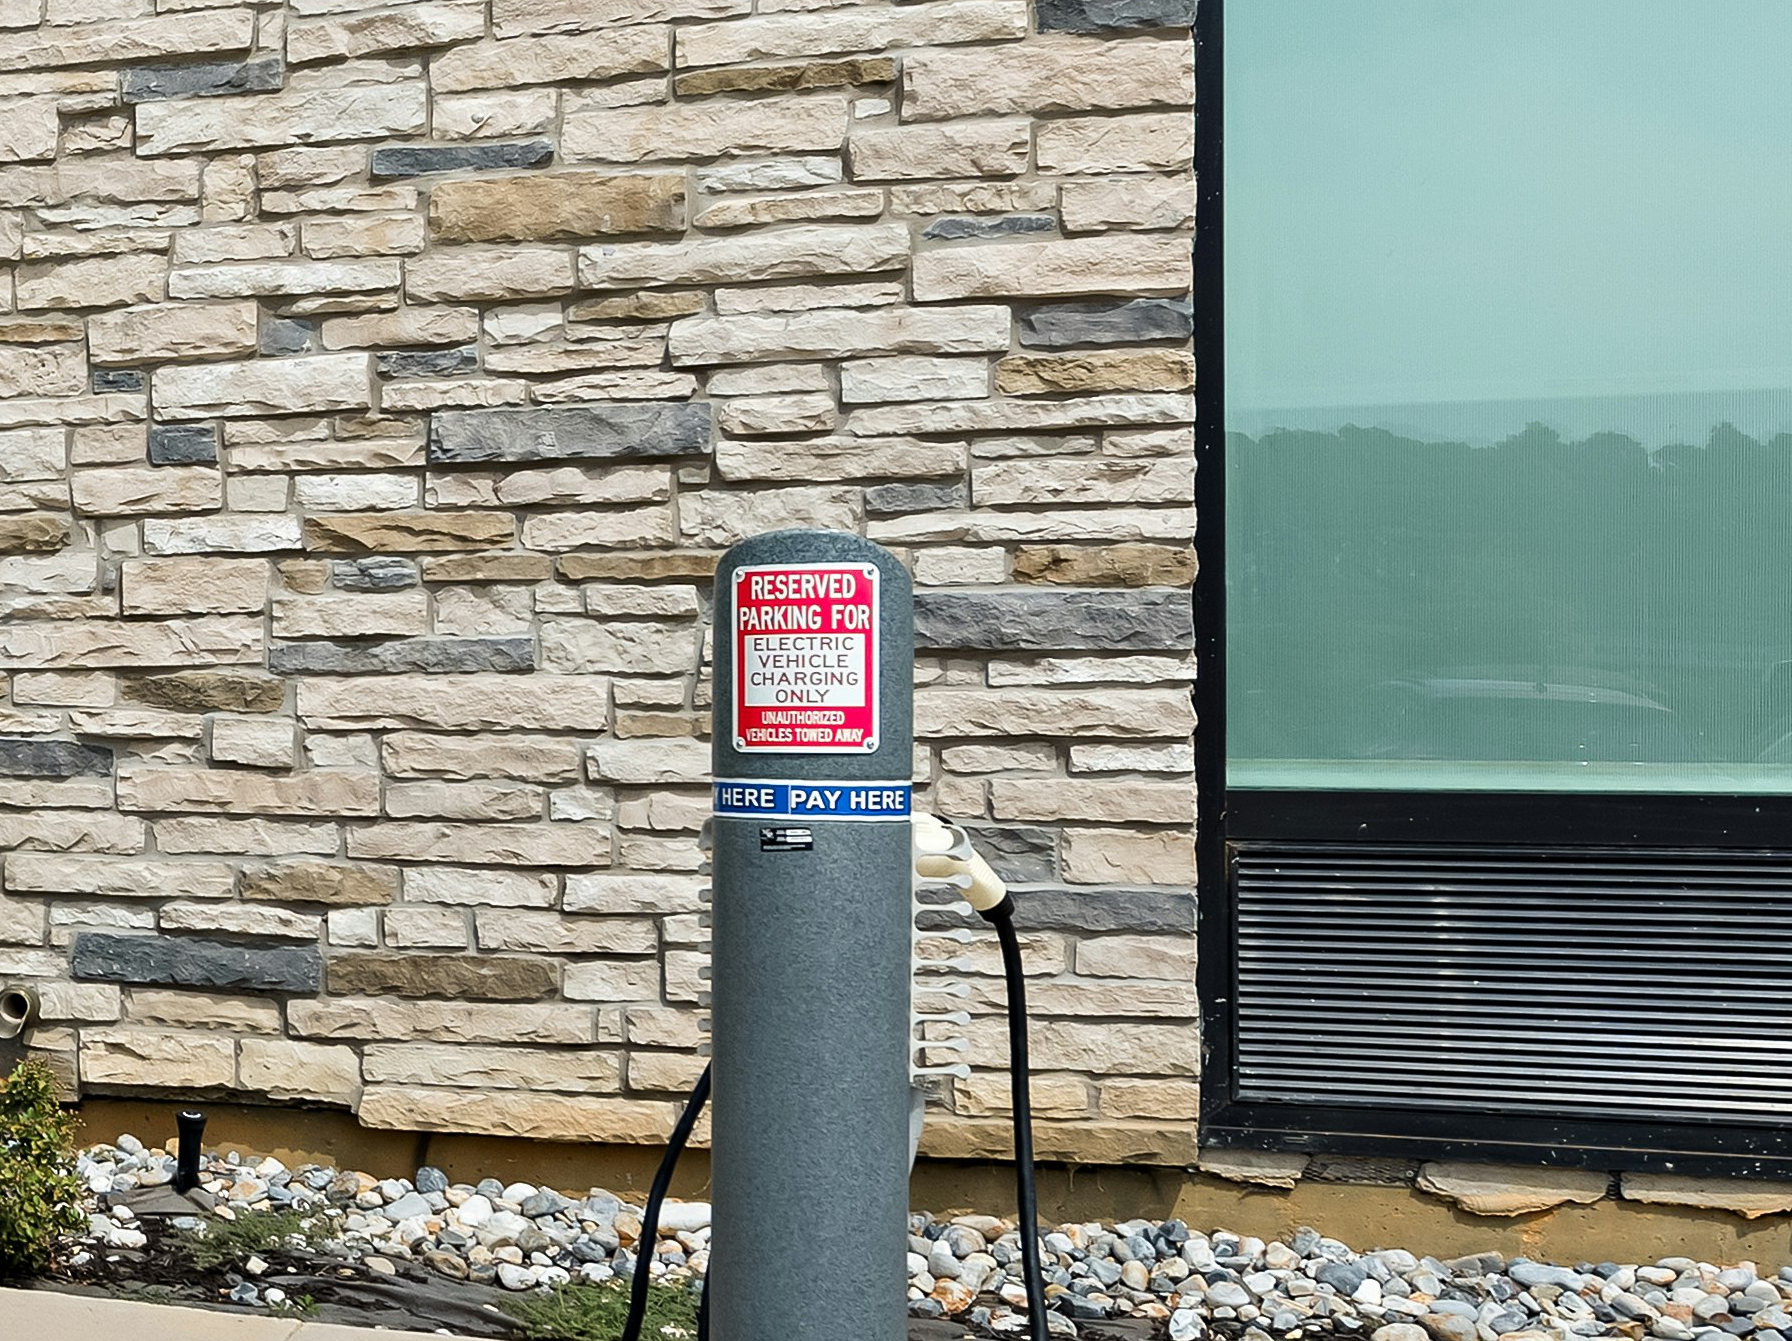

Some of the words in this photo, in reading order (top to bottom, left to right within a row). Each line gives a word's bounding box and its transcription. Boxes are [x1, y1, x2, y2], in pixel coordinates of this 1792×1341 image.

[750, 573, 856, 600] RESERVED
[739, 604, 822, 631] PARKING
[830, 604, 870, 630] FOR
[753, 636, 854, 652] ELECTRIC
[758, 654, 849, 669] VEHICLE
[750, 671, 859, 686] CHARGING
[775, 688, 830, 704] ONLY
[761, 710, 846, 725] UNAUTHORIZED
[745, 728, 793, 742] VEHICLES
[794, 728, 833, 742] TOWED
[834, 728, 864, 743] AWAY
[722, 787, 775, 807] HERE
[790, 789, 842, 810] PAY
[849, 789, 905, 810] HERE
